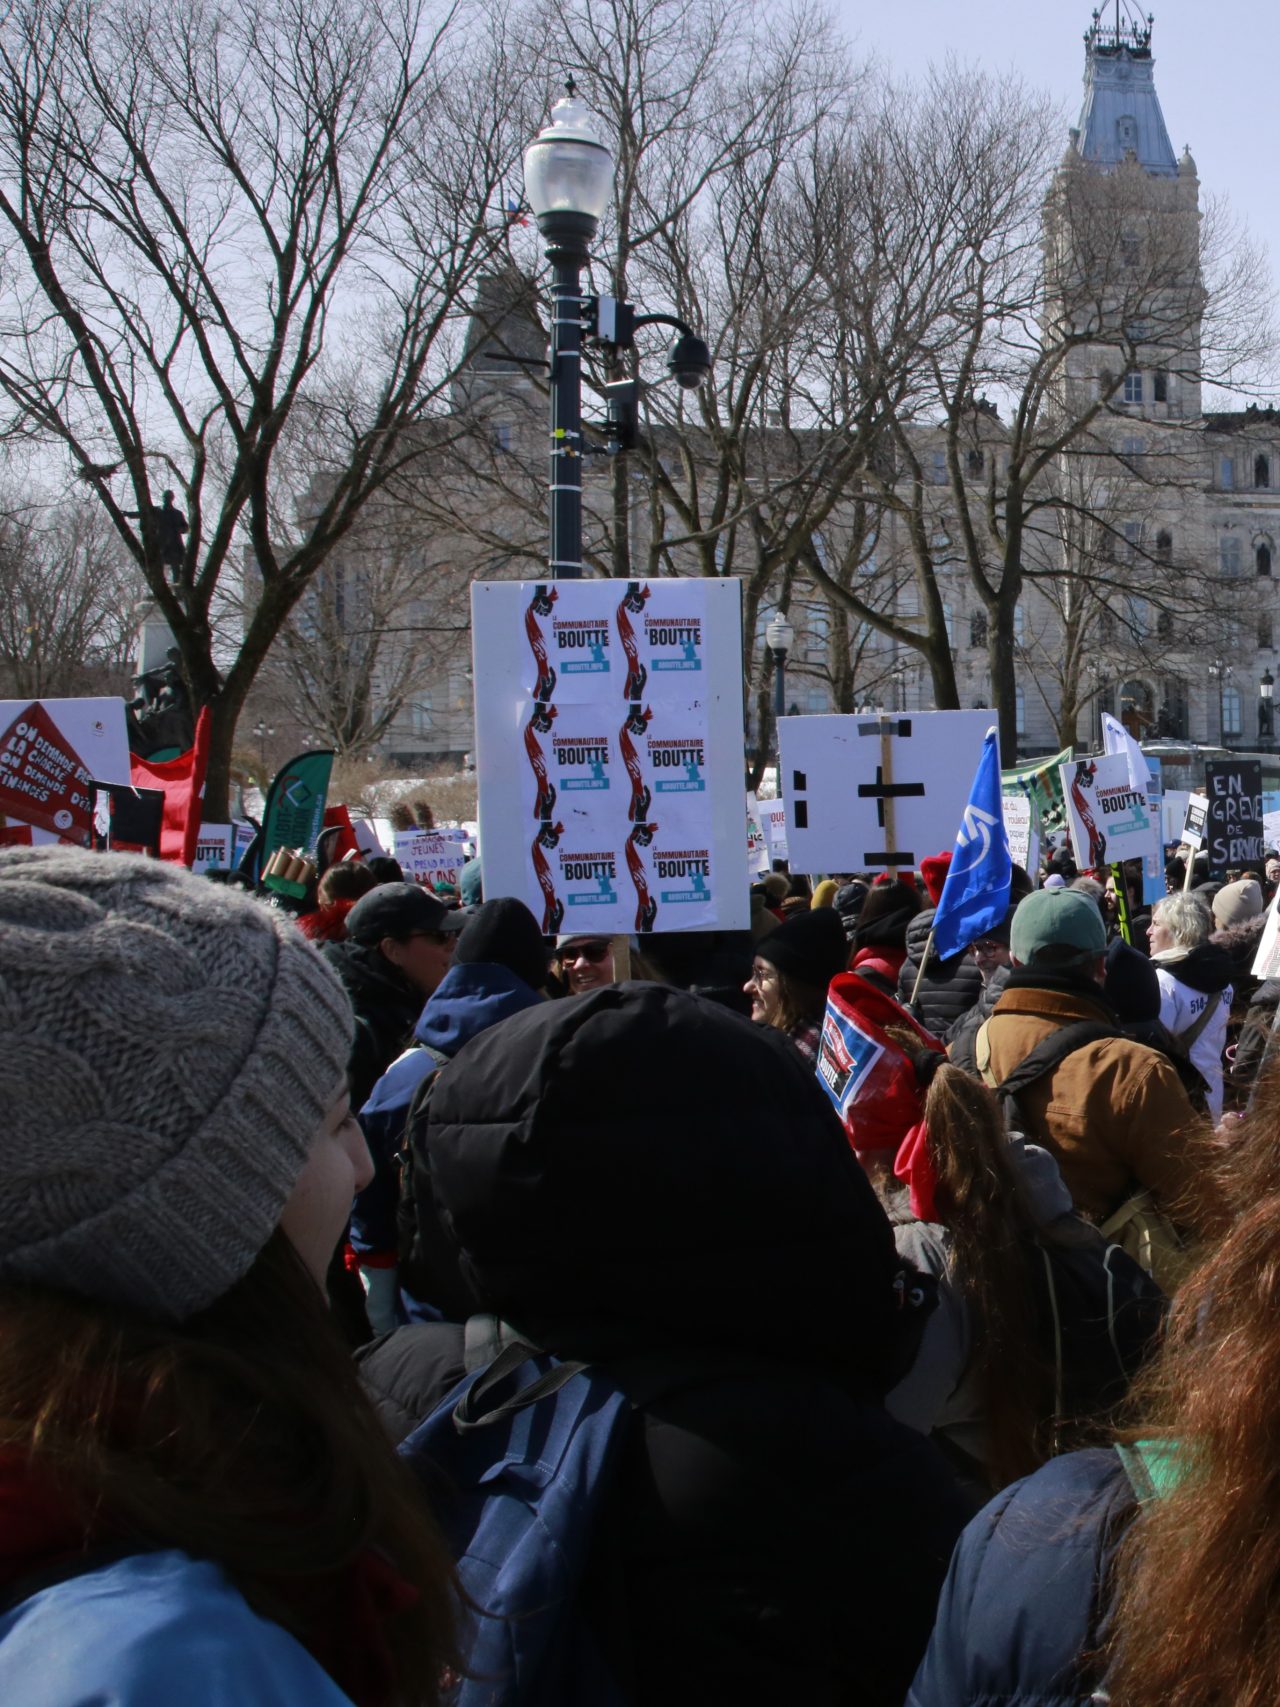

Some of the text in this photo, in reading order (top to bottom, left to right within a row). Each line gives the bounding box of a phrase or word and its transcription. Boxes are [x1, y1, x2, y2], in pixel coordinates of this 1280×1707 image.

[553, 620, 608, 629] COMMUNAUTAIRE
[644, 618, 701, 626] COMMUNAUTAIRE
[558, 630, 609, 648] BOUTTE
[649, 628, 701, 646] BOUTTE
[7, 737, 27, 756] LA
[16, 722, 38, 742] ON
[35, 737, 76, 773] DEMANDE
[553, 737, 608, 746] COMMUNAUTAIRE
[647, 739, 704, 748] COMMUNAUTAIRE
[558, 747, 609, 765] BOUTTE
[652, 749, 704, 767] BOUTTE
[0, 752, 21, 769] ON
[23, 765, 67, 795] DEMANDE
[1096, 785, 1131, 798] COMMUNAUT
[1213, 774, 1242, 796] EN
[1101, 792, 1146, 814] BOUTTE
[1226, 824, 1243, 835] DE
[197, 847, 225, 861] UTTE
[411, 844, 445, 856] JEUNES
[560, 852, 615, 862] COMMUNAUTAIRE
[653, 850, 709, 859] COMMUNAUTAIRE
[1212, 836, 1264, 864] SERVICE
[564, 862, 616, 880] BOUTTE
[657, 860, 709, 878] BOUTTE
